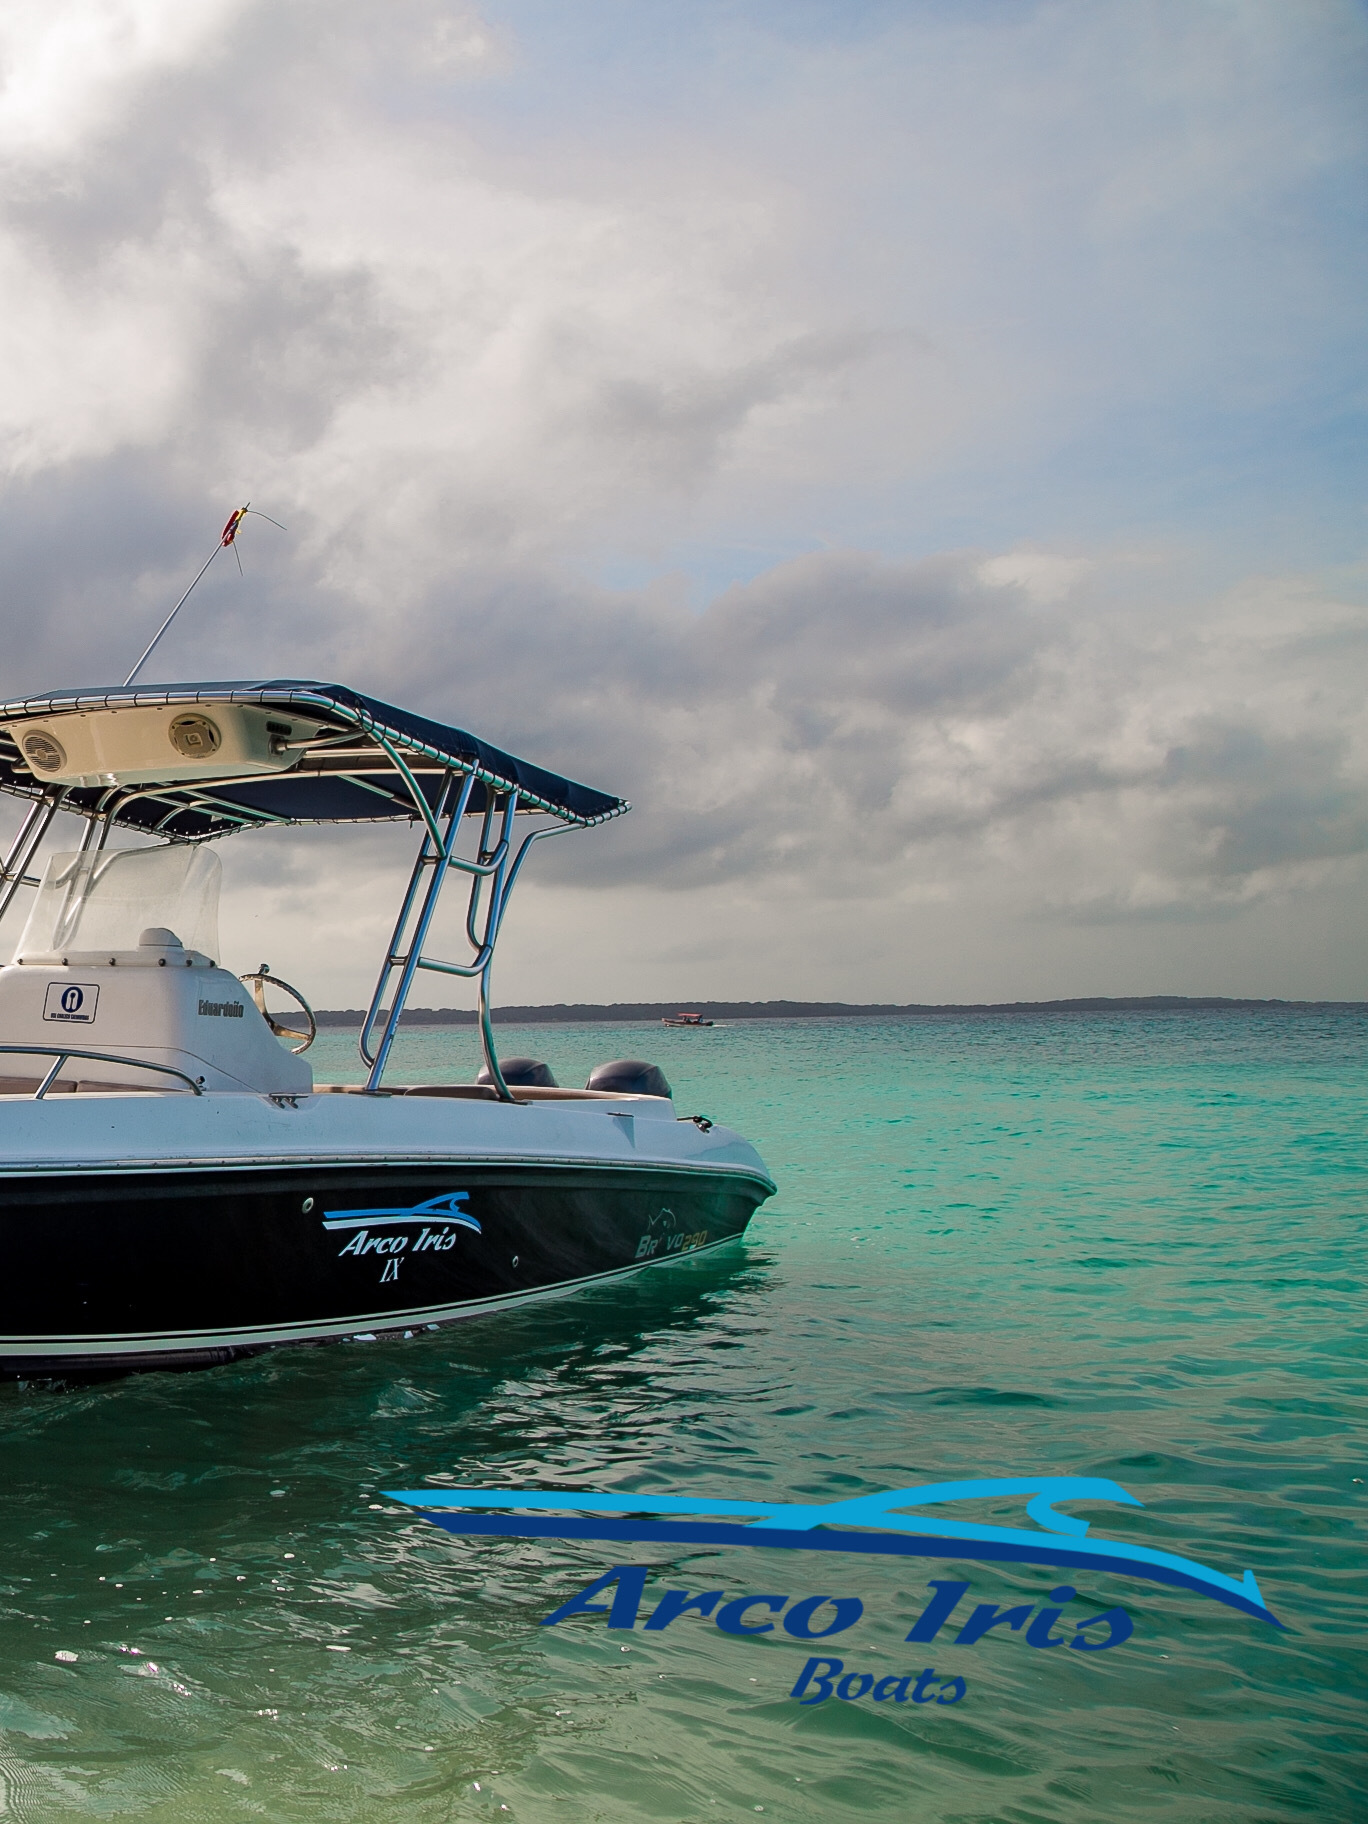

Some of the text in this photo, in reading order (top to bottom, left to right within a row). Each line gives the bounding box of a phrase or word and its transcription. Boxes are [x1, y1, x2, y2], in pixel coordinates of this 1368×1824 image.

[338, 1227, 456, 1256] Arco Iris
[379, 1257, 404, 1283] IX
